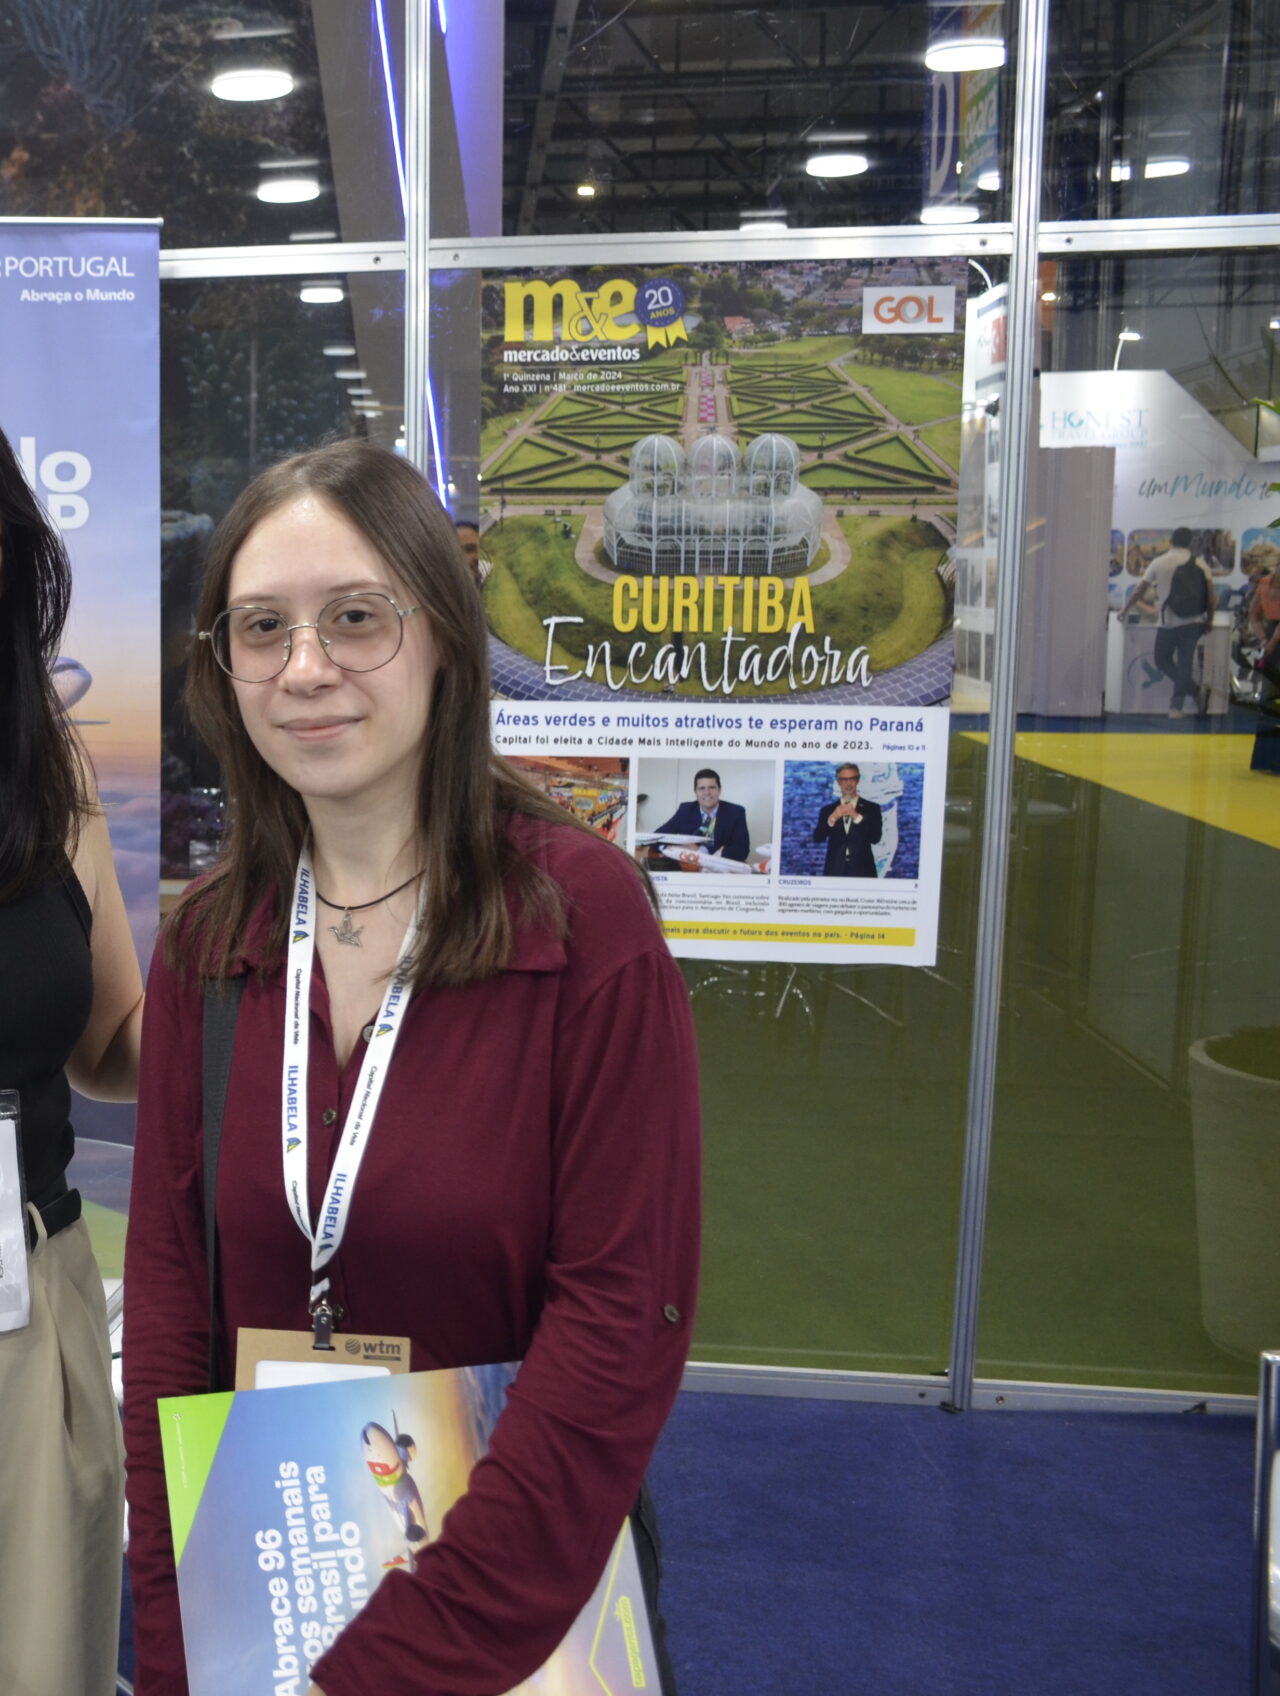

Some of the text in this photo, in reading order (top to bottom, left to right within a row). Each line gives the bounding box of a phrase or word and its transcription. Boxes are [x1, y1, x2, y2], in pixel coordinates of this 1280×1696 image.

[20, 289, 135, 304] Abraça o Mundo
[645, 286, 673, 311] 20
[650, 307, 675, 319] ANOS
[873, 295, 944, 324] GOL
[503, 346, 640, 362] mercado&eventos
[503, 384, 520, 393] Ano
[521, 384, 537, 393] XXI
[512, 370, 622, 382] Quinzena Março de 2024
[612, 574, 816, 634] CURITIBA
[542, 615, 874, 694] Encantadora
[496, 709, 924, 733] Áreas verdes e muitos atrativos te esperam no Paraná
[495, 735, 531, 746] Capital
[535, 735, 549, 745] foi
[553, 735, 583, 746] eleita
[587, 737, 593, 746] a
[597, 736, 634, 747] Cidade
[637, 736, 661, 747] Mais
[665, 737, 724, 749] Inteligente
[728, 738, 741, 748] do
[745, 739, 780, 749] Mundo
[784, 740, 797, 749] no
[801, 740, 821, 750] ano
[825, 740, 838, 750] de
[842, 740, 873, 750] 2023.
[295, 867, 310, 926] ILHABELA
[781, 930, 810, 938] eventos
[286, 1065, 299, 1132] ILHABELA
[322, 1173, 347, 1241] ILHABELA
[363, 1339, 401, 1355] wtm
[306, 1465, 340, 1542] para
[275, 1460, 318, 1615] semanais
[255, 1528, 300, 1696] Abrace 96
